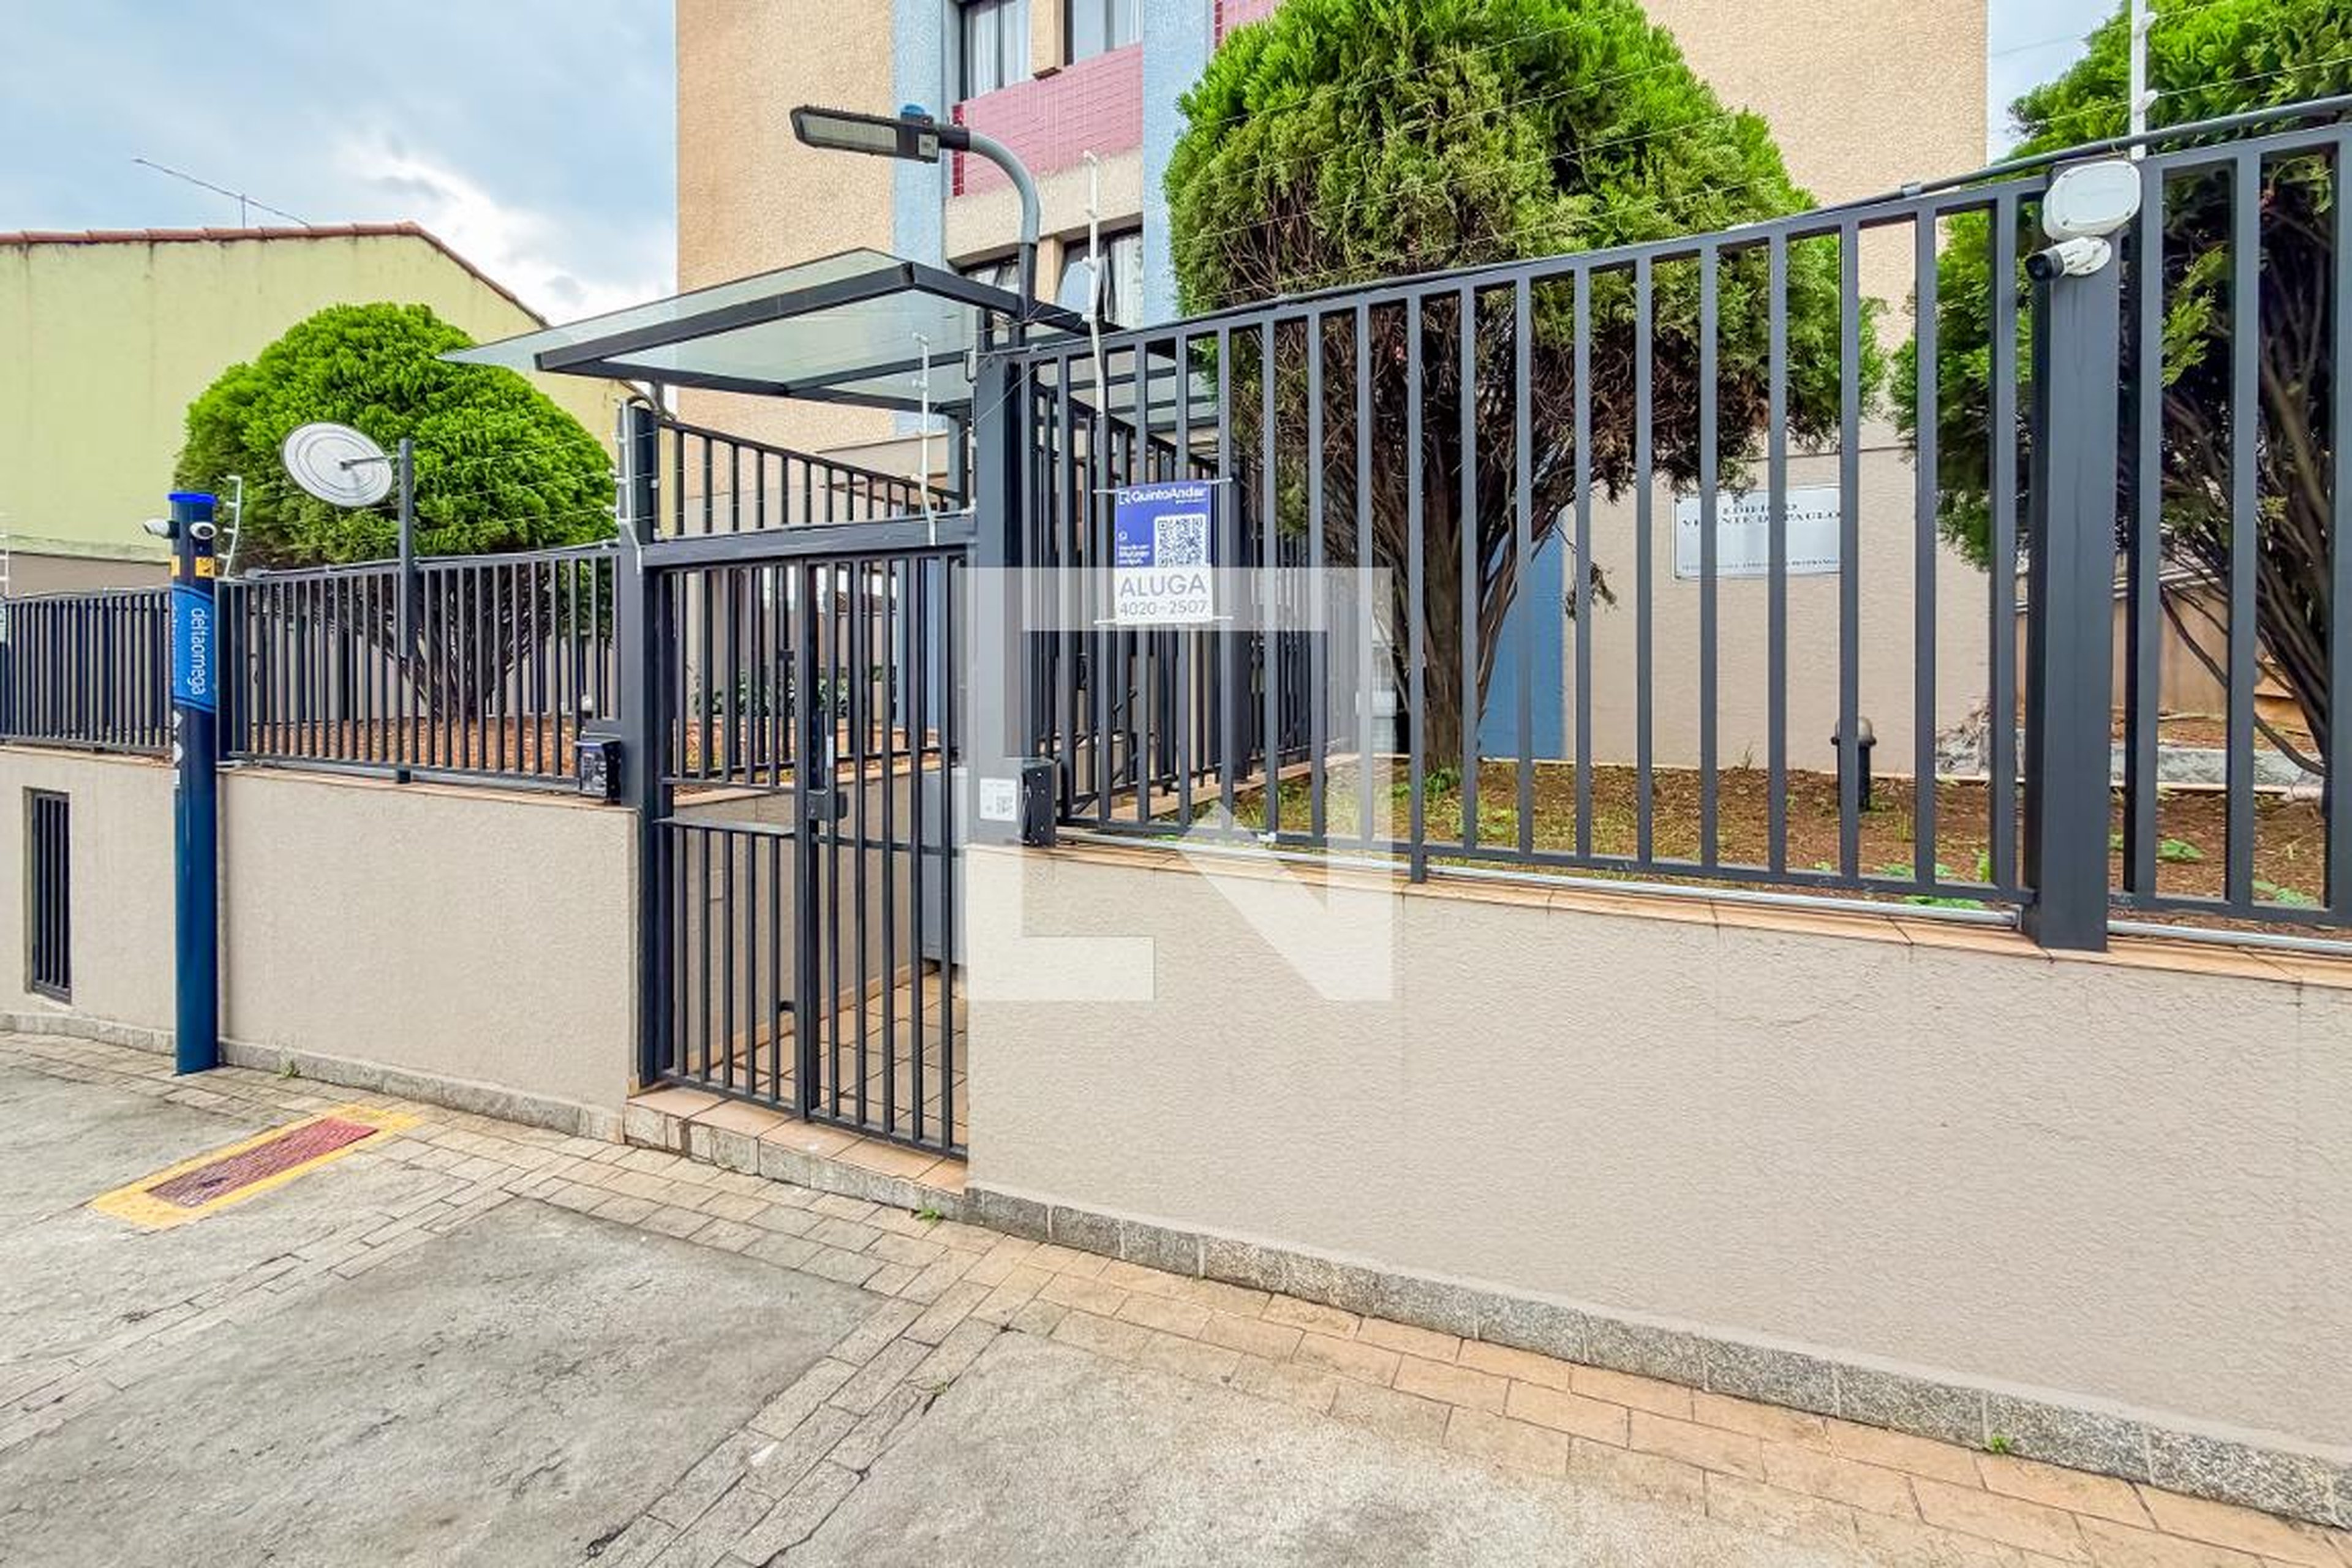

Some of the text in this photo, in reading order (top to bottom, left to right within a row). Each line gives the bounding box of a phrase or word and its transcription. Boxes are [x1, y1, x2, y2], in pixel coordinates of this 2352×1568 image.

[1120, 573, 1207, 598] ALUGA
[1120, 600, 1208, 616] 4020-2507
[187, 607, 210, 696] deltaomega
